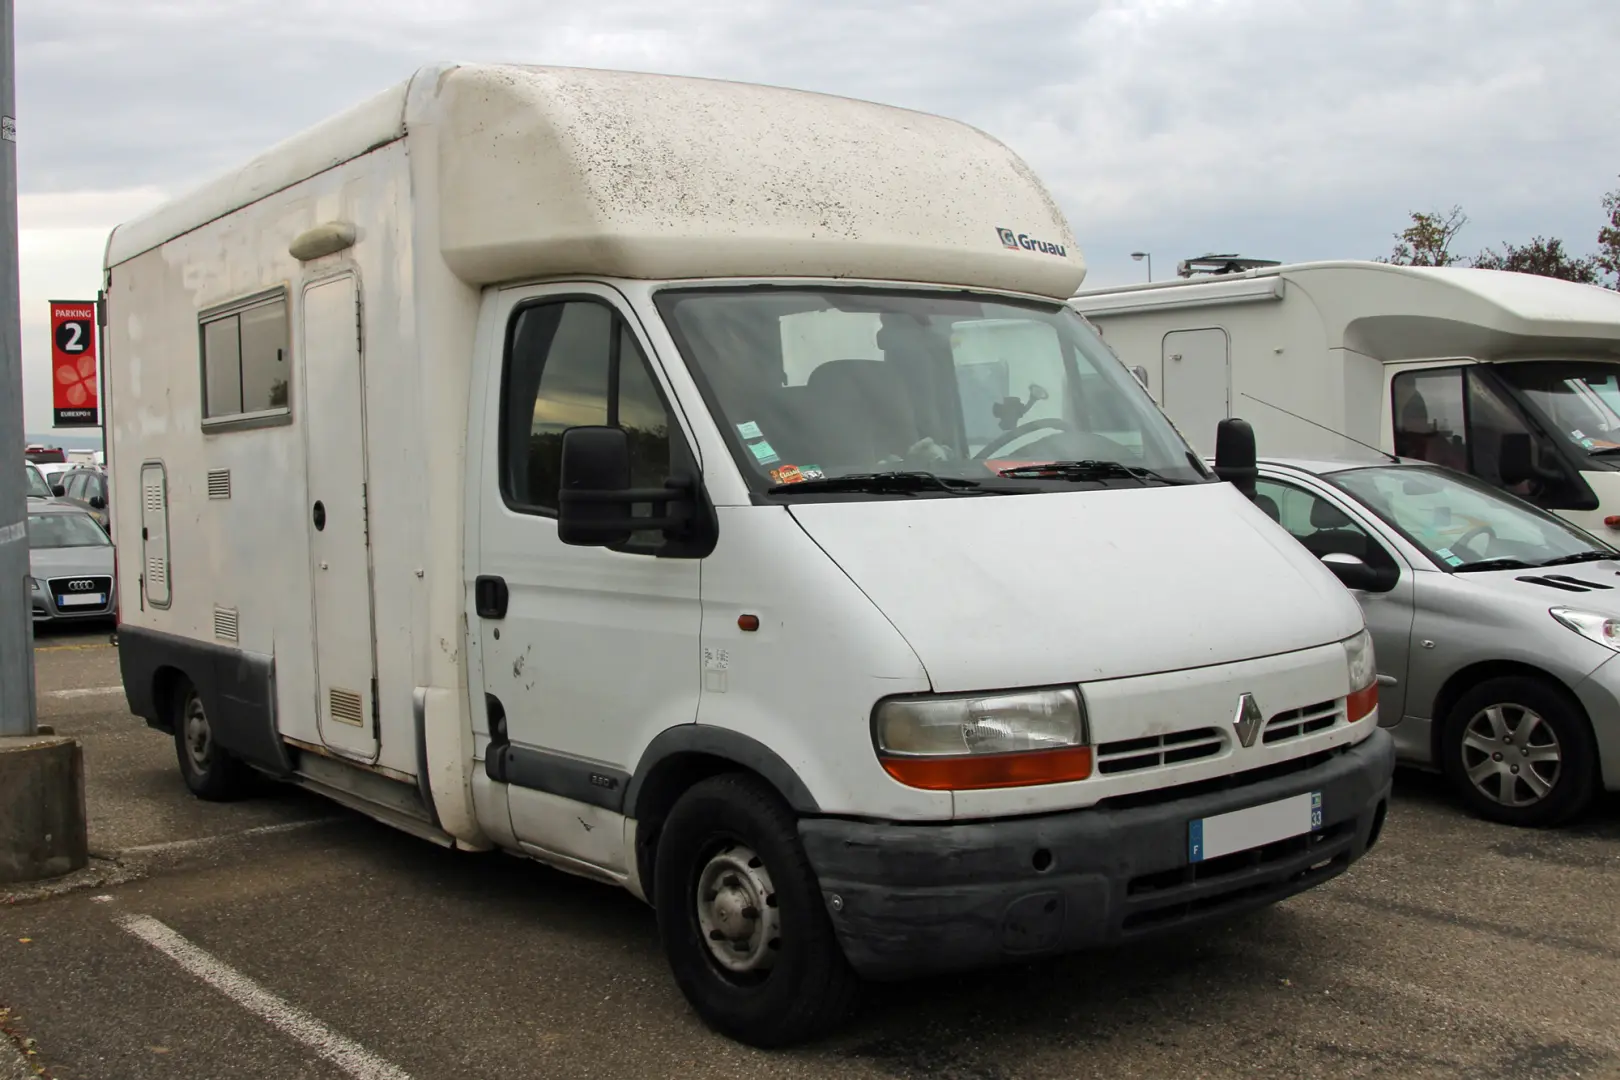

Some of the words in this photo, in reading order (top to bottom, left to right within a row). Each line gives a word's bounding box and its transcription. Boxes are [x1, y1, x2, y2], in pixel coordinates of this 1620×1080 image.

[1017, 233, 1067, 257] Gruau
[55, 309, 92, 318] PARKING
[65, 322, 83, 351] 2
[1311, 811, 1322, 826] 33
[1193, 845, 1199, 855] F
